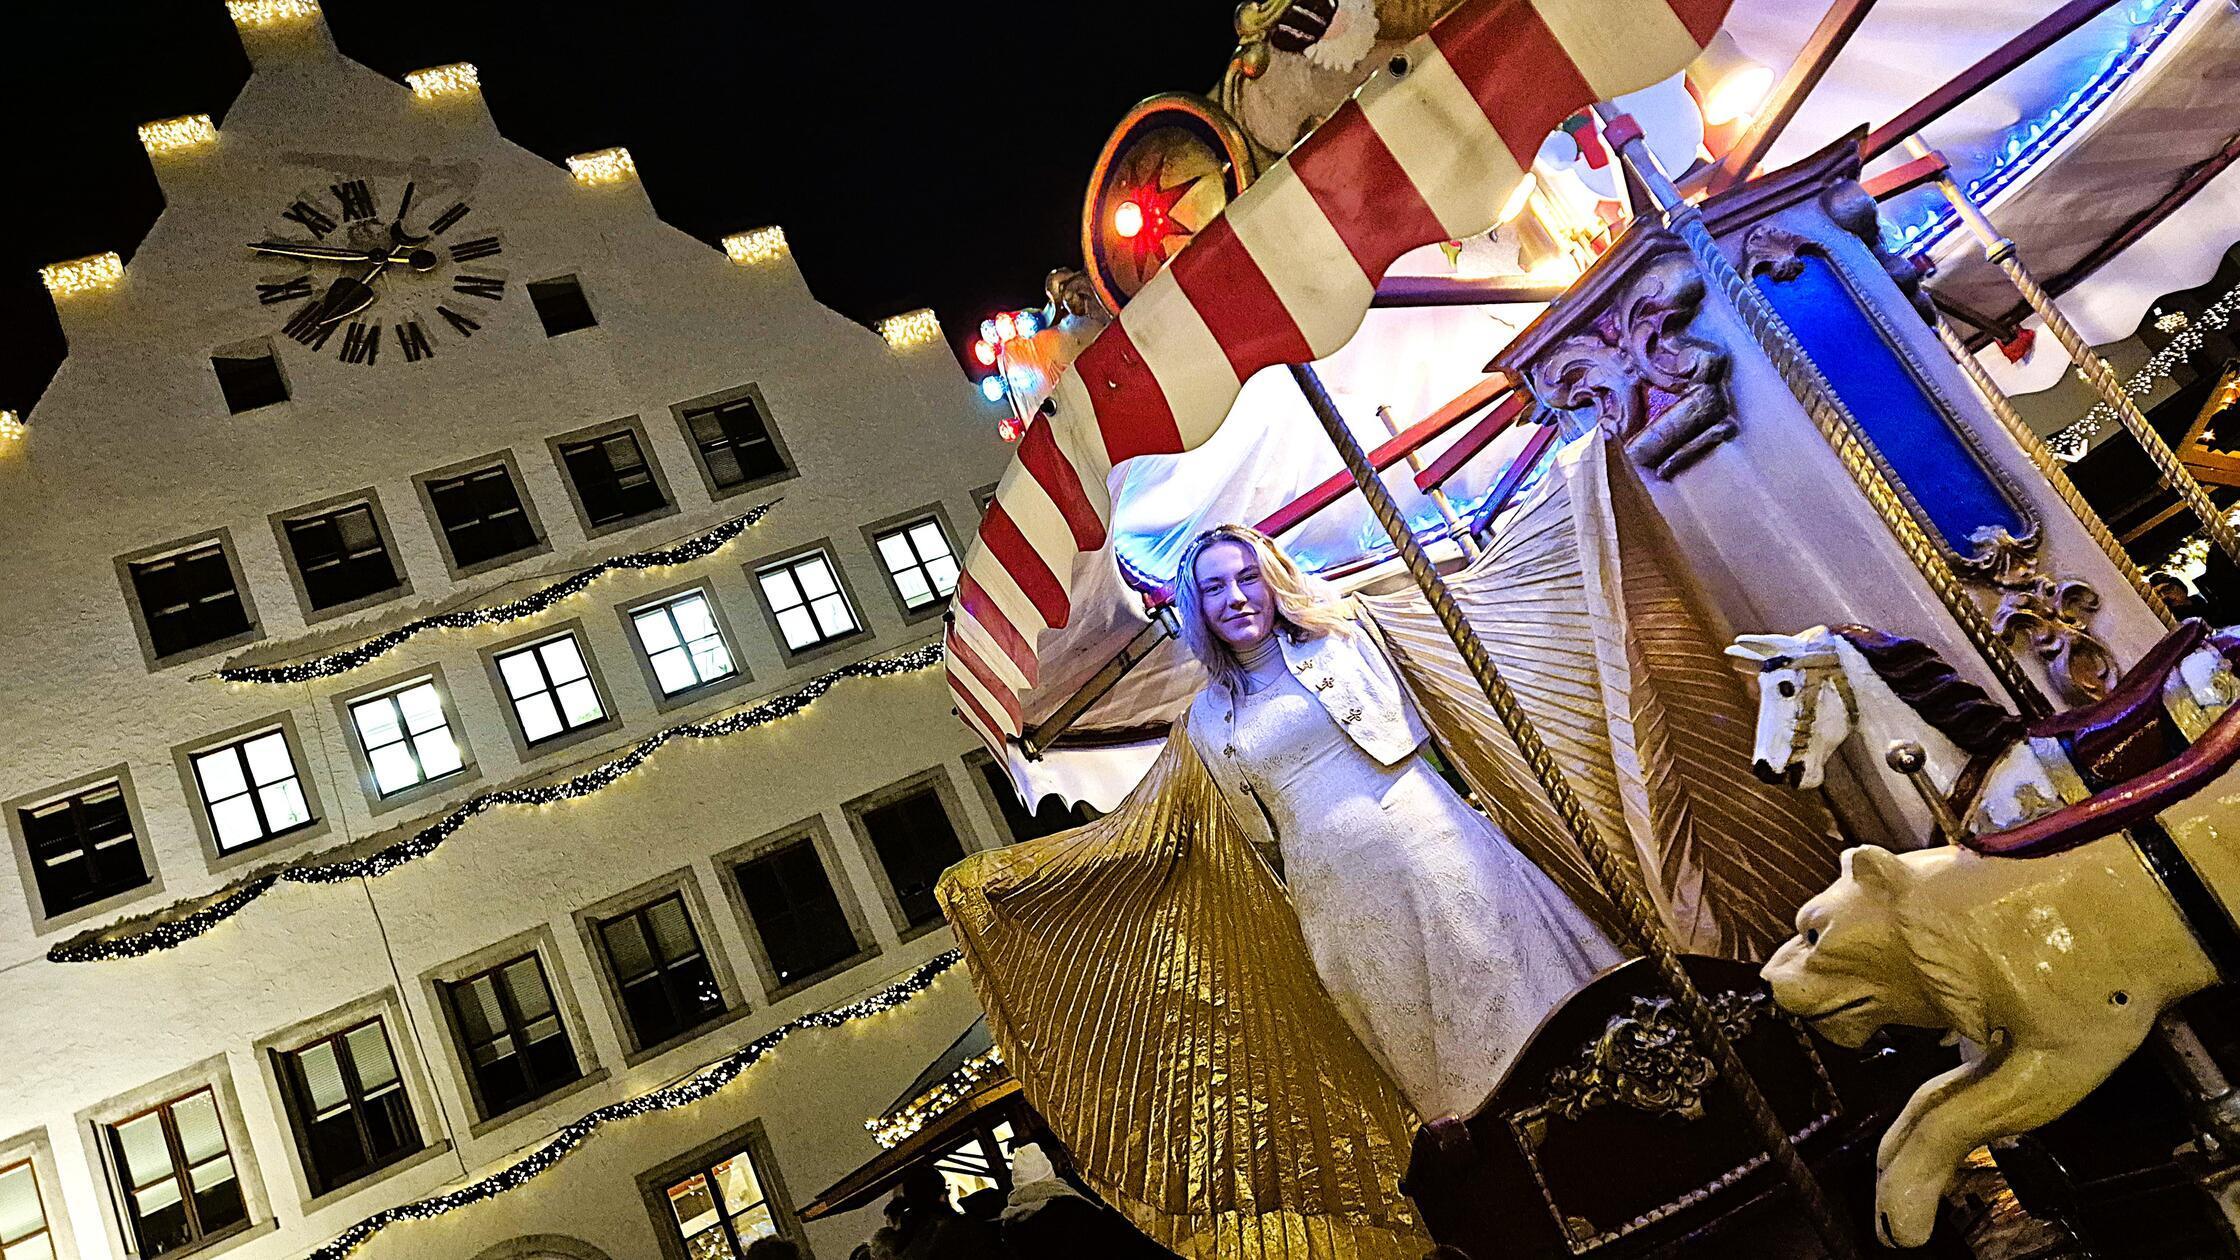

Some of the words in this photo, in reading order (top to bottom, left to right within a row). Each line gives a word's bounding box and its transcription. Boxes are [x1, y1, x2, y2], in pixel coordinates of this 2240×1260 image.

[428, 202, 471, 235] II
[449, 236, 502, 263] III
[255, 275, 313, 305] IX
[339, 321, 381, 366] VII
[395, 321, 434, 363] VI
